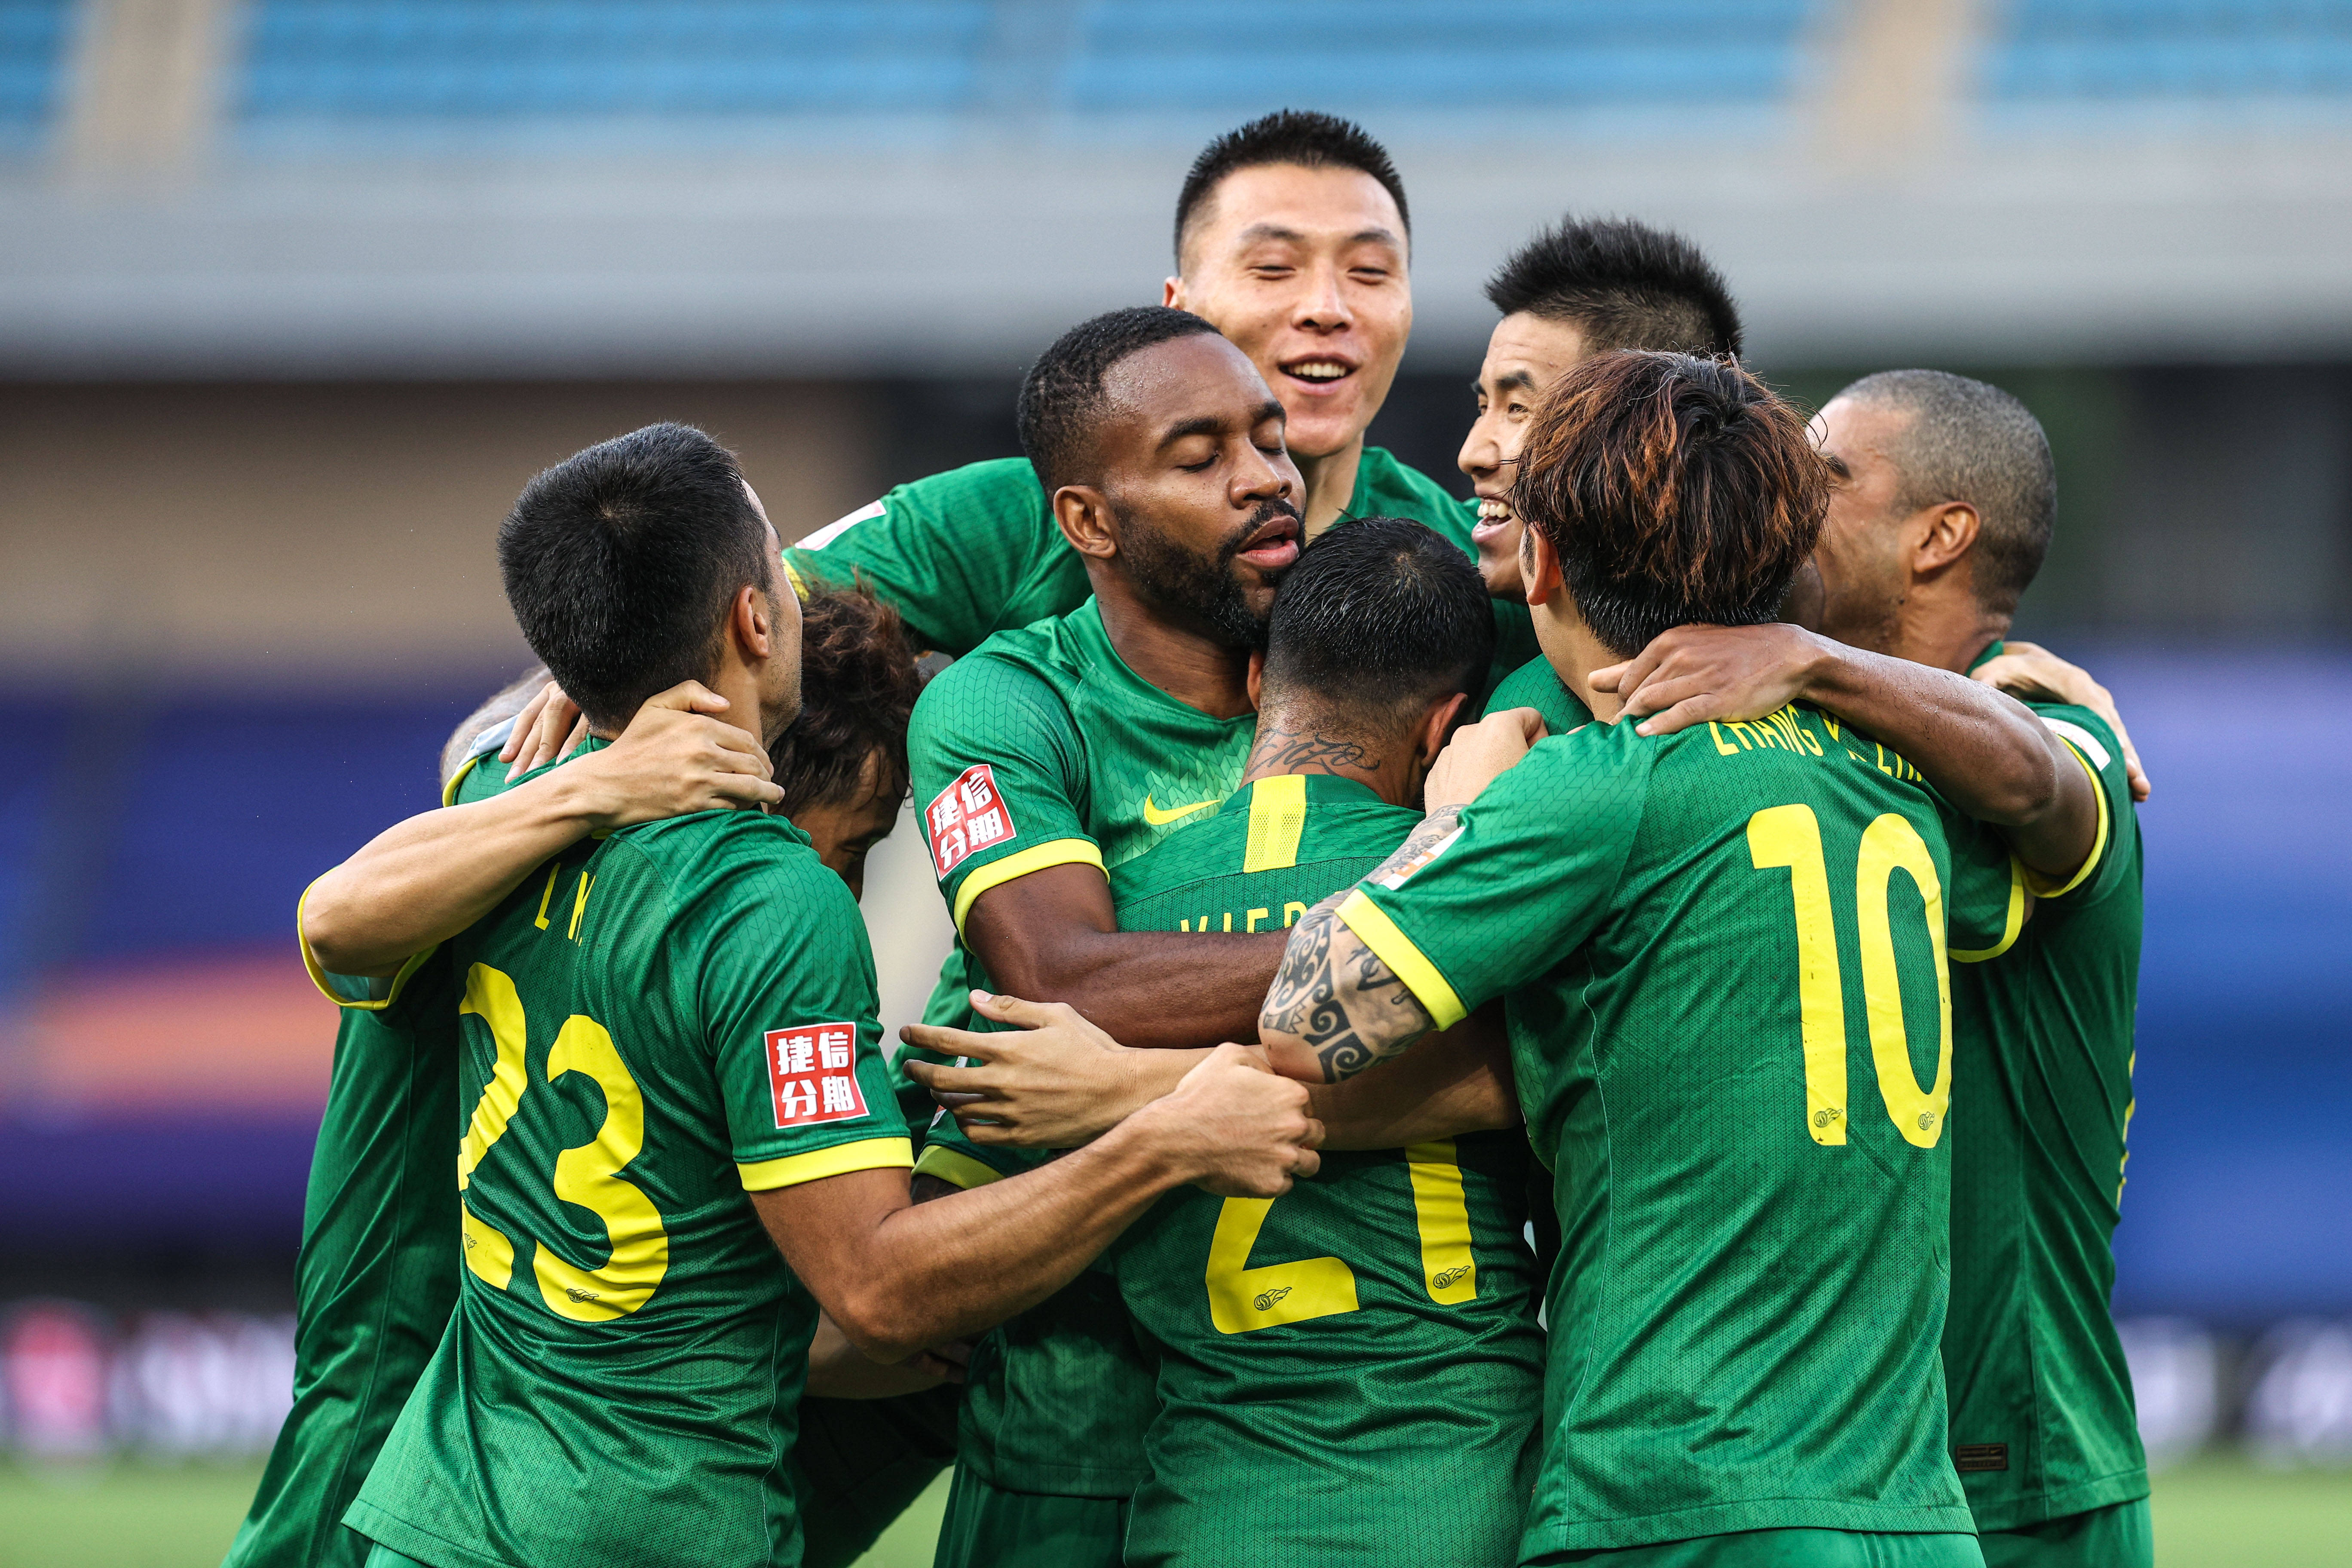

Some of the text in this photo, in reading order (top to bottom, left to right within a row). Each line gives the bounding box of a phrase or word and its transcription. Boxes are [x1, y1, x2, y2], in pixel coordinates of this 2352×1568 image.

[932, 772, 993, 836] 捷信
[940, 806, 1004, 870] 分期
[1747, 803, 1953, 1148] 10
[776, 1032, 849, 1075] 捷信
[781, 1076, 856, 1119] 分期
[458, 962, 668, 1323] 23
